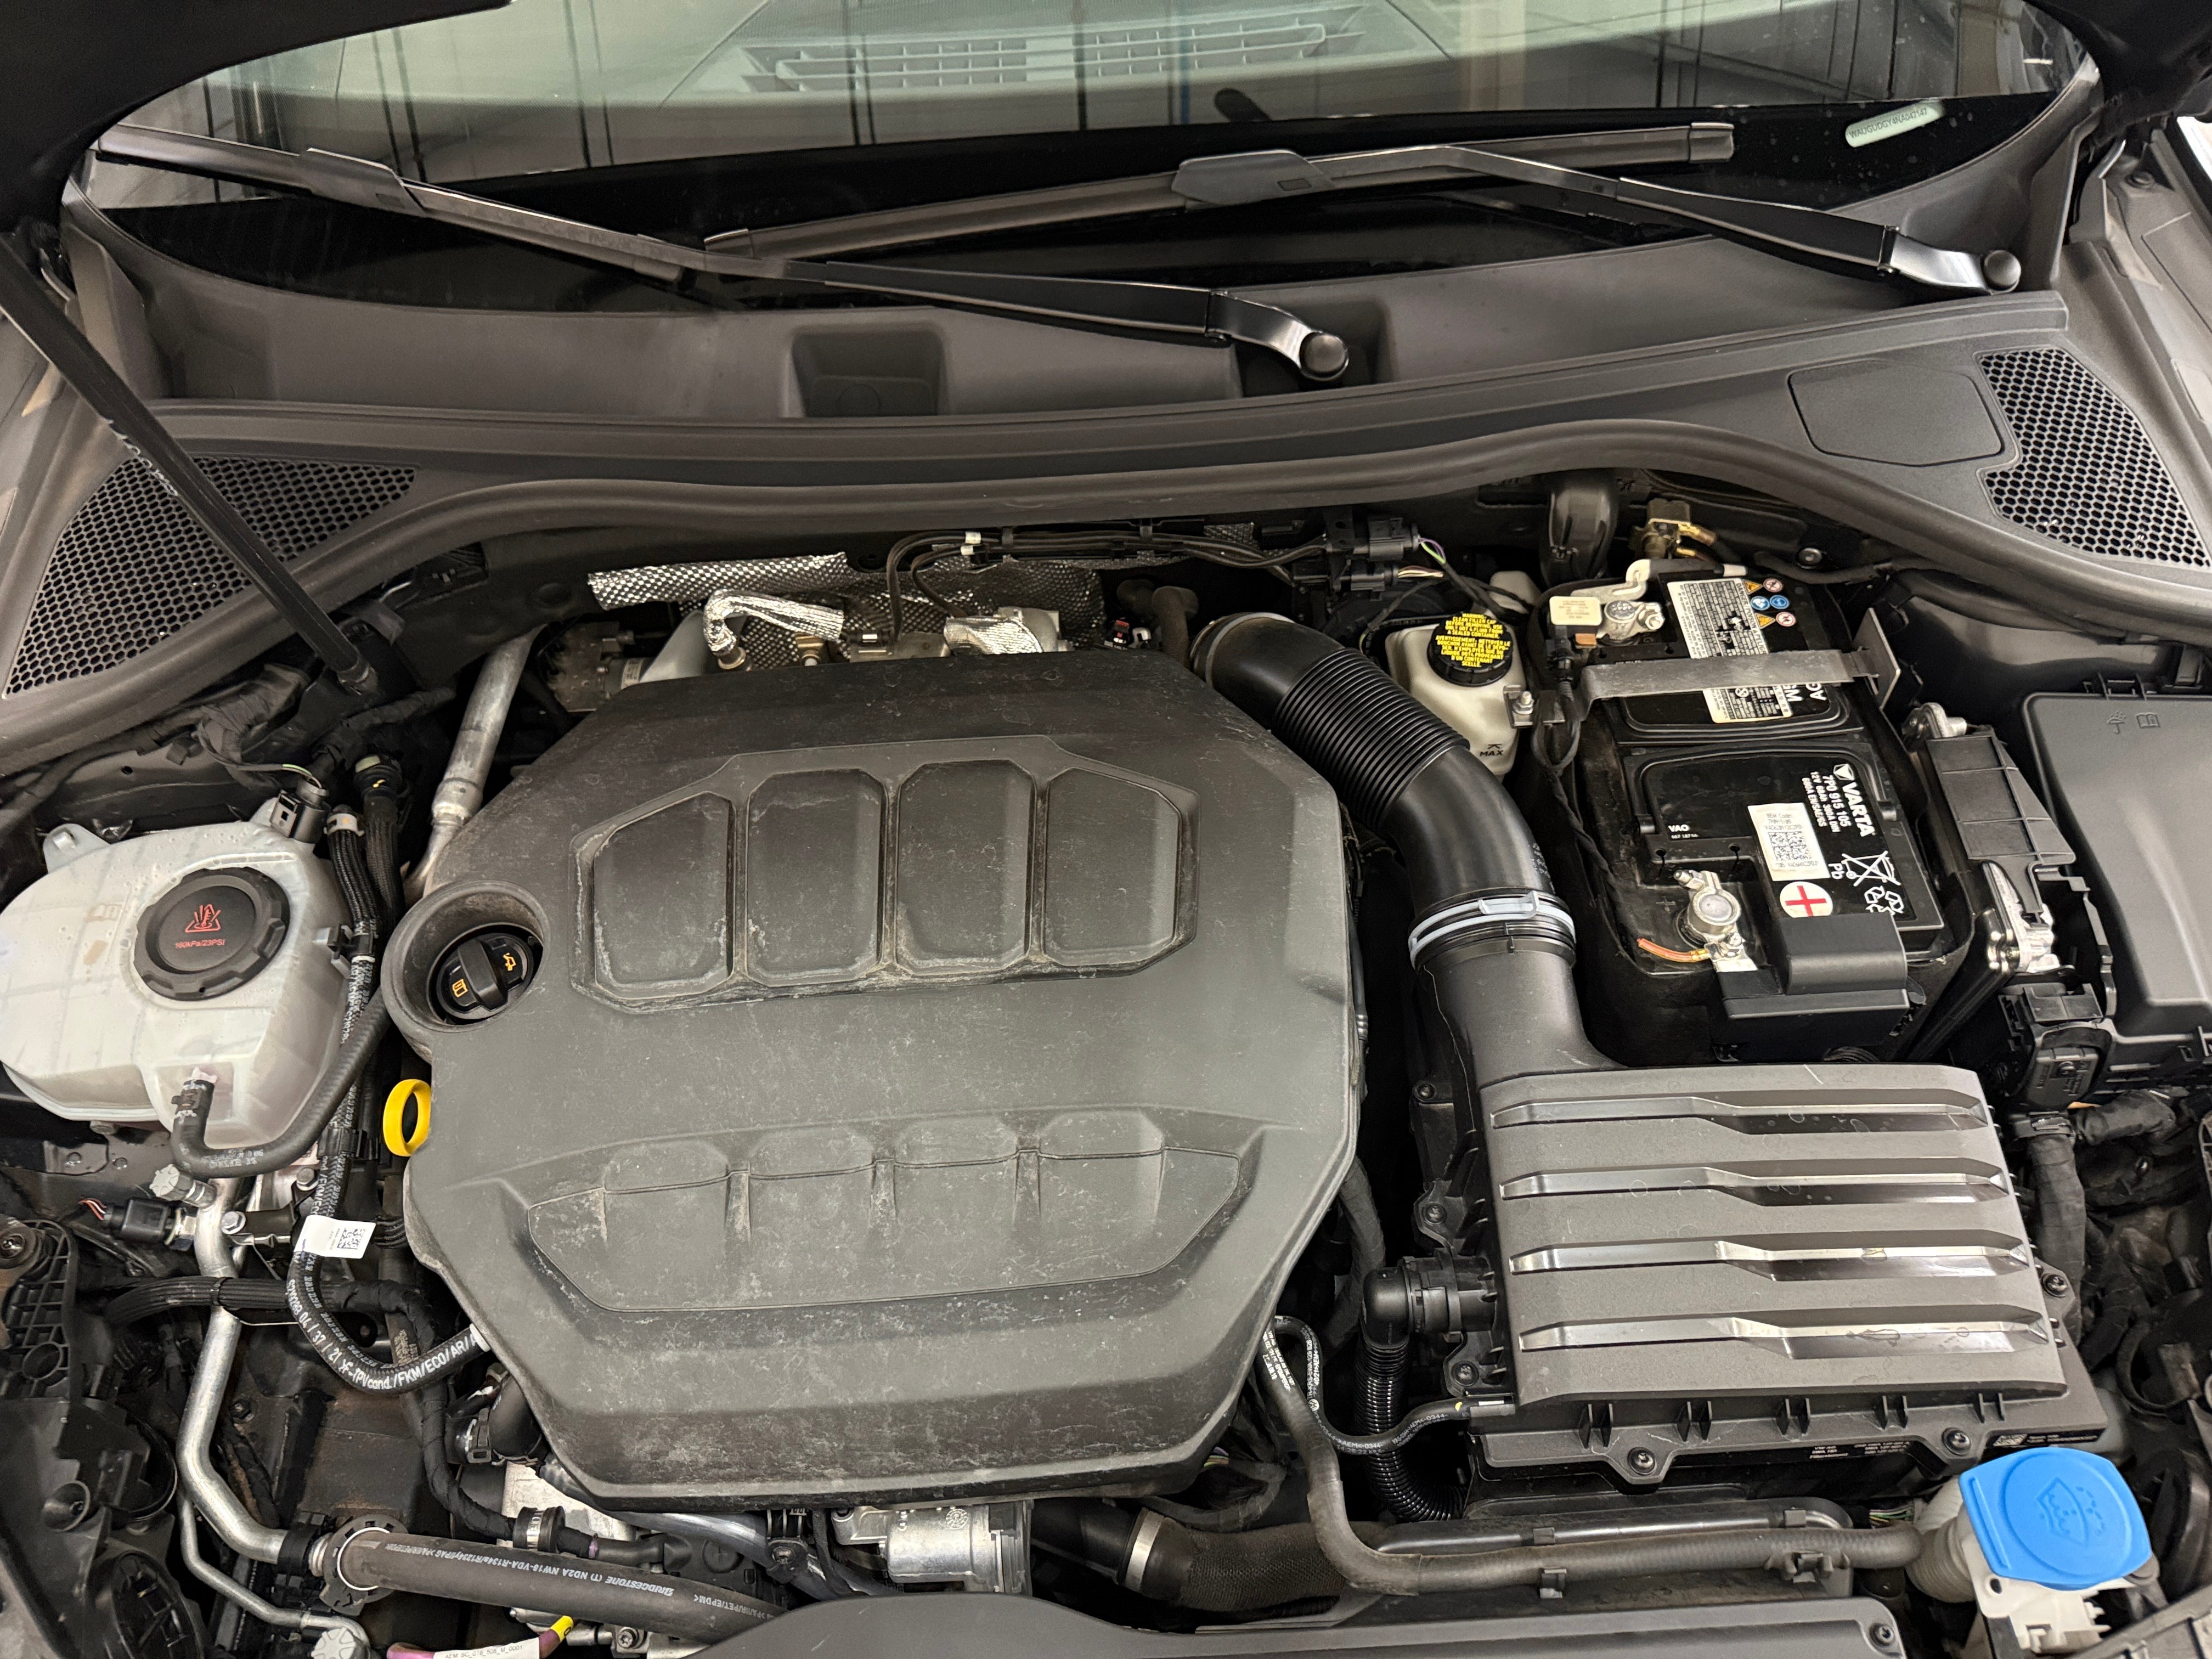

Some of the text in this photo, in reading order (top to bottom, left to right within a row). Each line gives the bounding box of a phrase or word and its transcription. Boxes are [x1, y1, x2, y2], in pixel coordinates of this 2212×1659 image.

[1849, 108, 1928, 139] WAUGUDGY4NA047147
[1810, 771, 1822, 783] 12V
[1822, 774, 1852, 827] 7P0 915 105
[1842, 782, 1875, 837] VARTA
[1827, 862, 1844, 880] Pb
[328, 1347, 343, 1364] 21
[562, 1568, 589, 1580] ND2A
[605, 1576, 675, 1596] BRIDGESTONE
